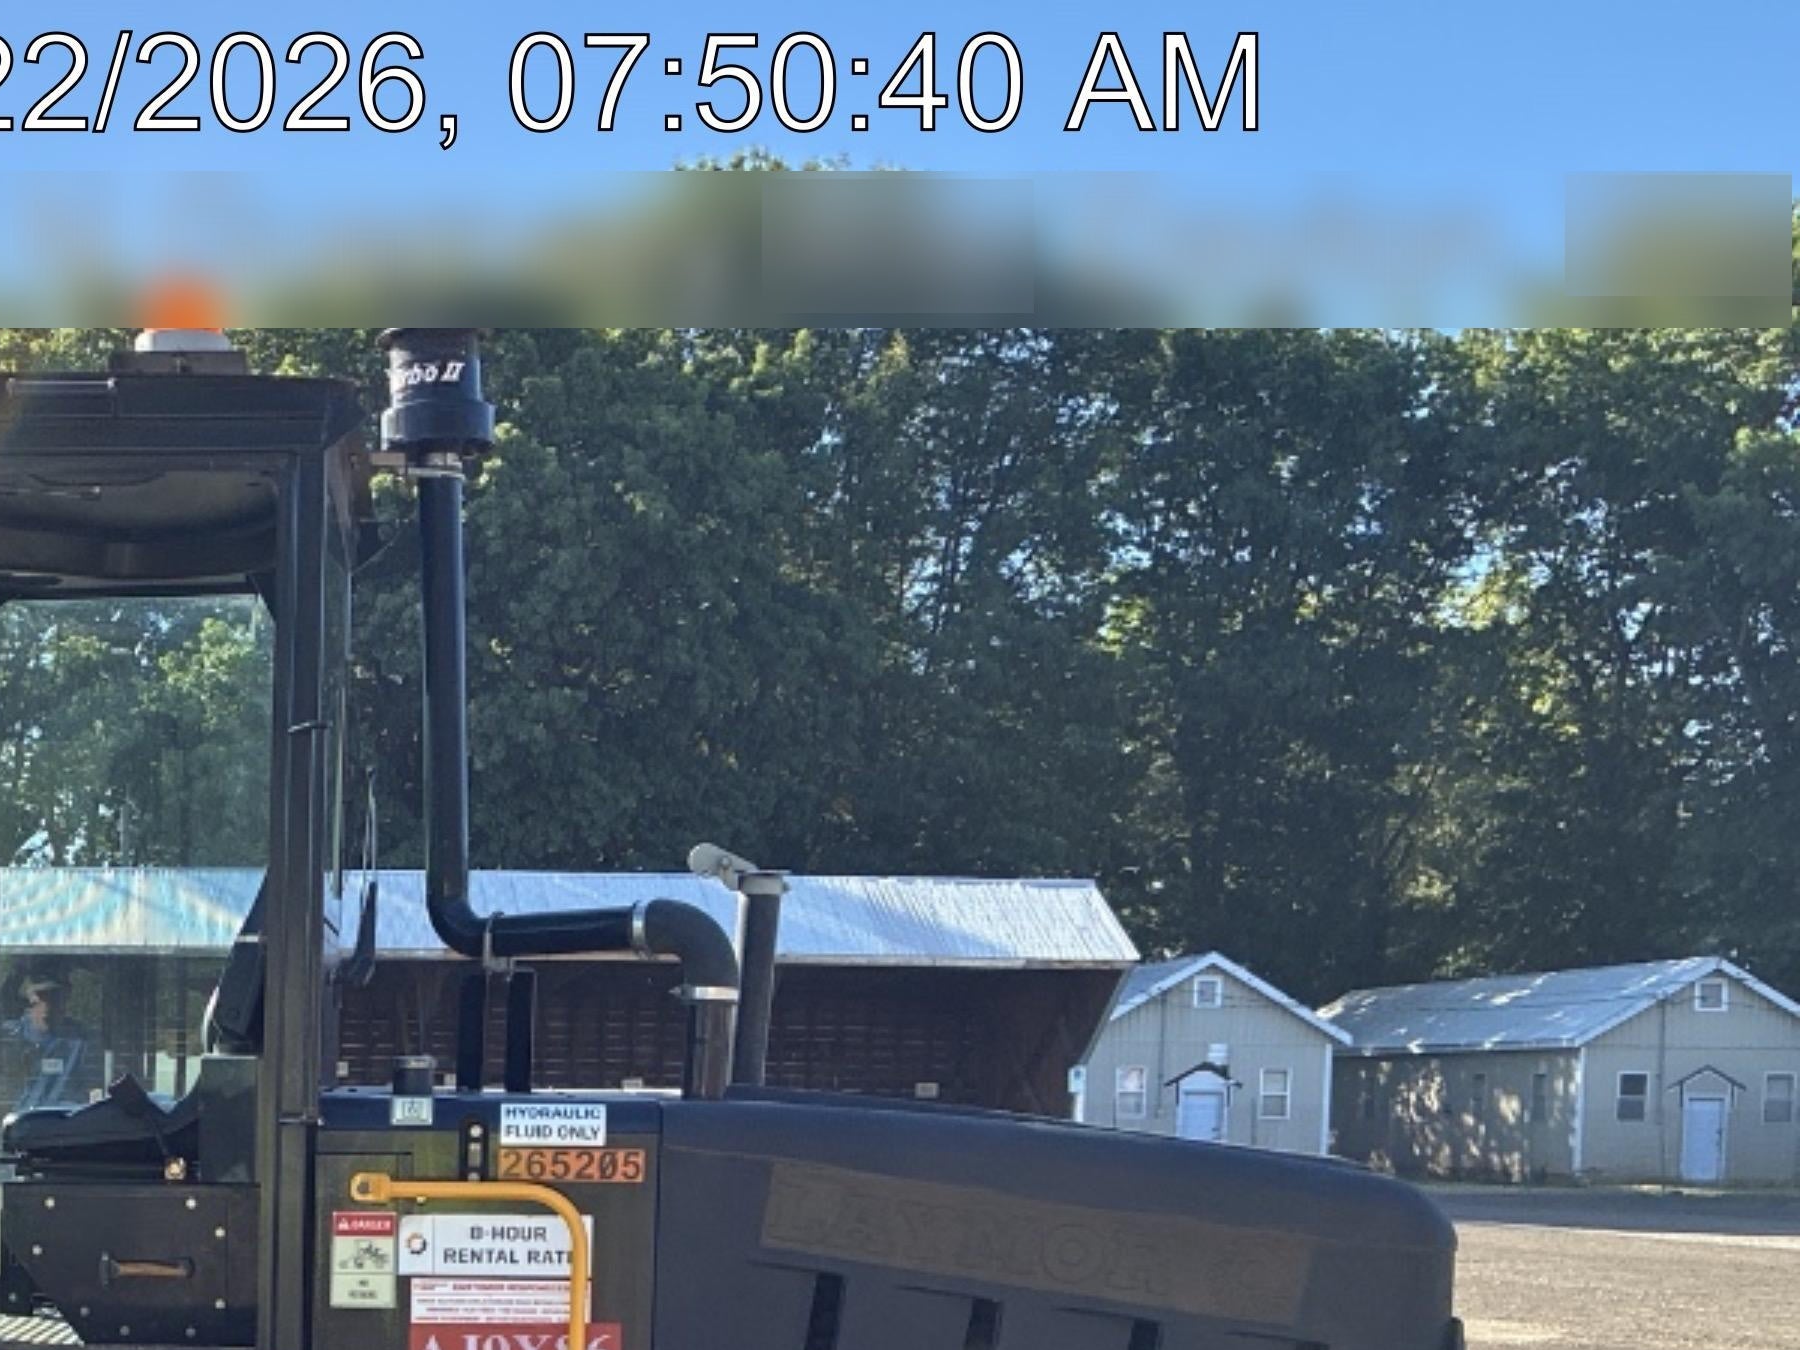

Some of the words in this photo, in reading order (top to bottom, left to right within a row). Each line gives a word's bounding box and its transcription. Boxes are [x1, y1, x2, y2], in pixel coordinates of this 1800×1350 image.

[506, 1106, 601, 1120] HYDRAULIC
[505, 1124, 552, 1138] FLUID
[557, 1125, 600, 1140] ONLY
[502, 1151, 641, 1179] 265205
[443, 1247, 519, 1264] RENTAL
